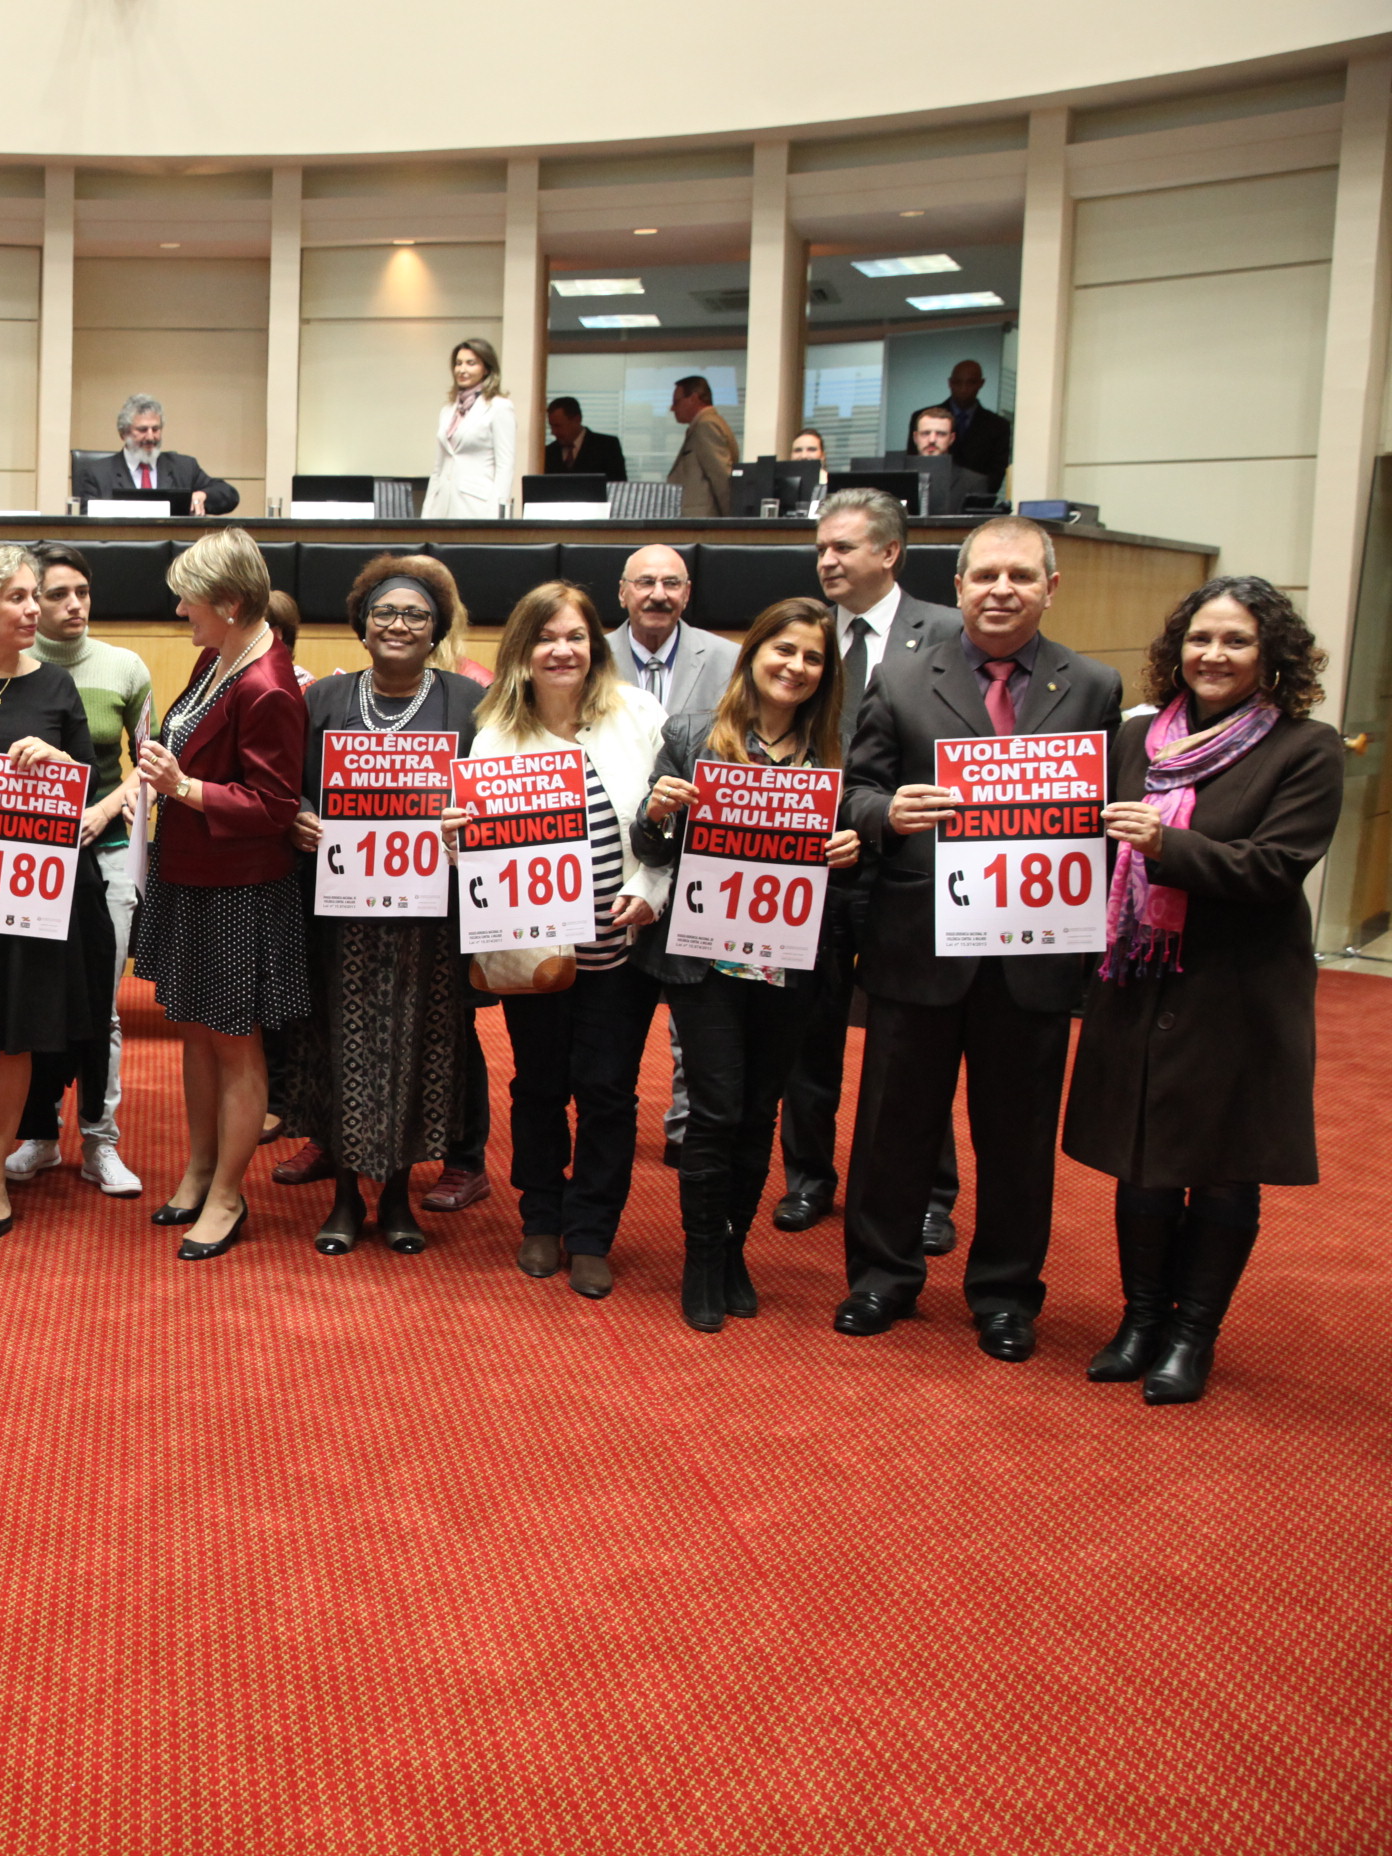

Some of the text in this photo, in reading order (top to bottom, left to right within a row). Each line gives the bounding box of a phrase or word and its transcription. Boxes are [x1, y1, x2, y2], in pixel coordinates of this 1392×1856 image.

[330, 734, 450, 752] VIOLÊNCIA
[944, 738, 1096, 762] VIOLÊNCIA
[344, 754, 435, 770] CONTRA
[458, 753, 577, 780] VIOLÊNCIA
[962, 760, 1078, 782] CONTRA
[328, 772, 448, 787] A MULHER:
[475, 774, 566, 797] CONTRA
[703, 766, 832, 791] VIOLÊNCIA
[465, 791, 581, 816] A MULHER:
[715, 788, 815, 810] CONTRA
[949, 781, 1097, 802] A MULHER:
[327, 793, 447, 816] DENUNCIE!
[465, 813, 584, 847] DENUNCIE!
[695, 805, 829, 830] A MULHER:
[945, 806, 1099, 837] DENUNCIE!
[356, 830, 439, 877] 180
[691, 826, 827, 862] DENUNCIE!
[499, 853, 582, 908] 180
[983, 851, 1092, 908] 180
[719, 871, 813, 927] 180
